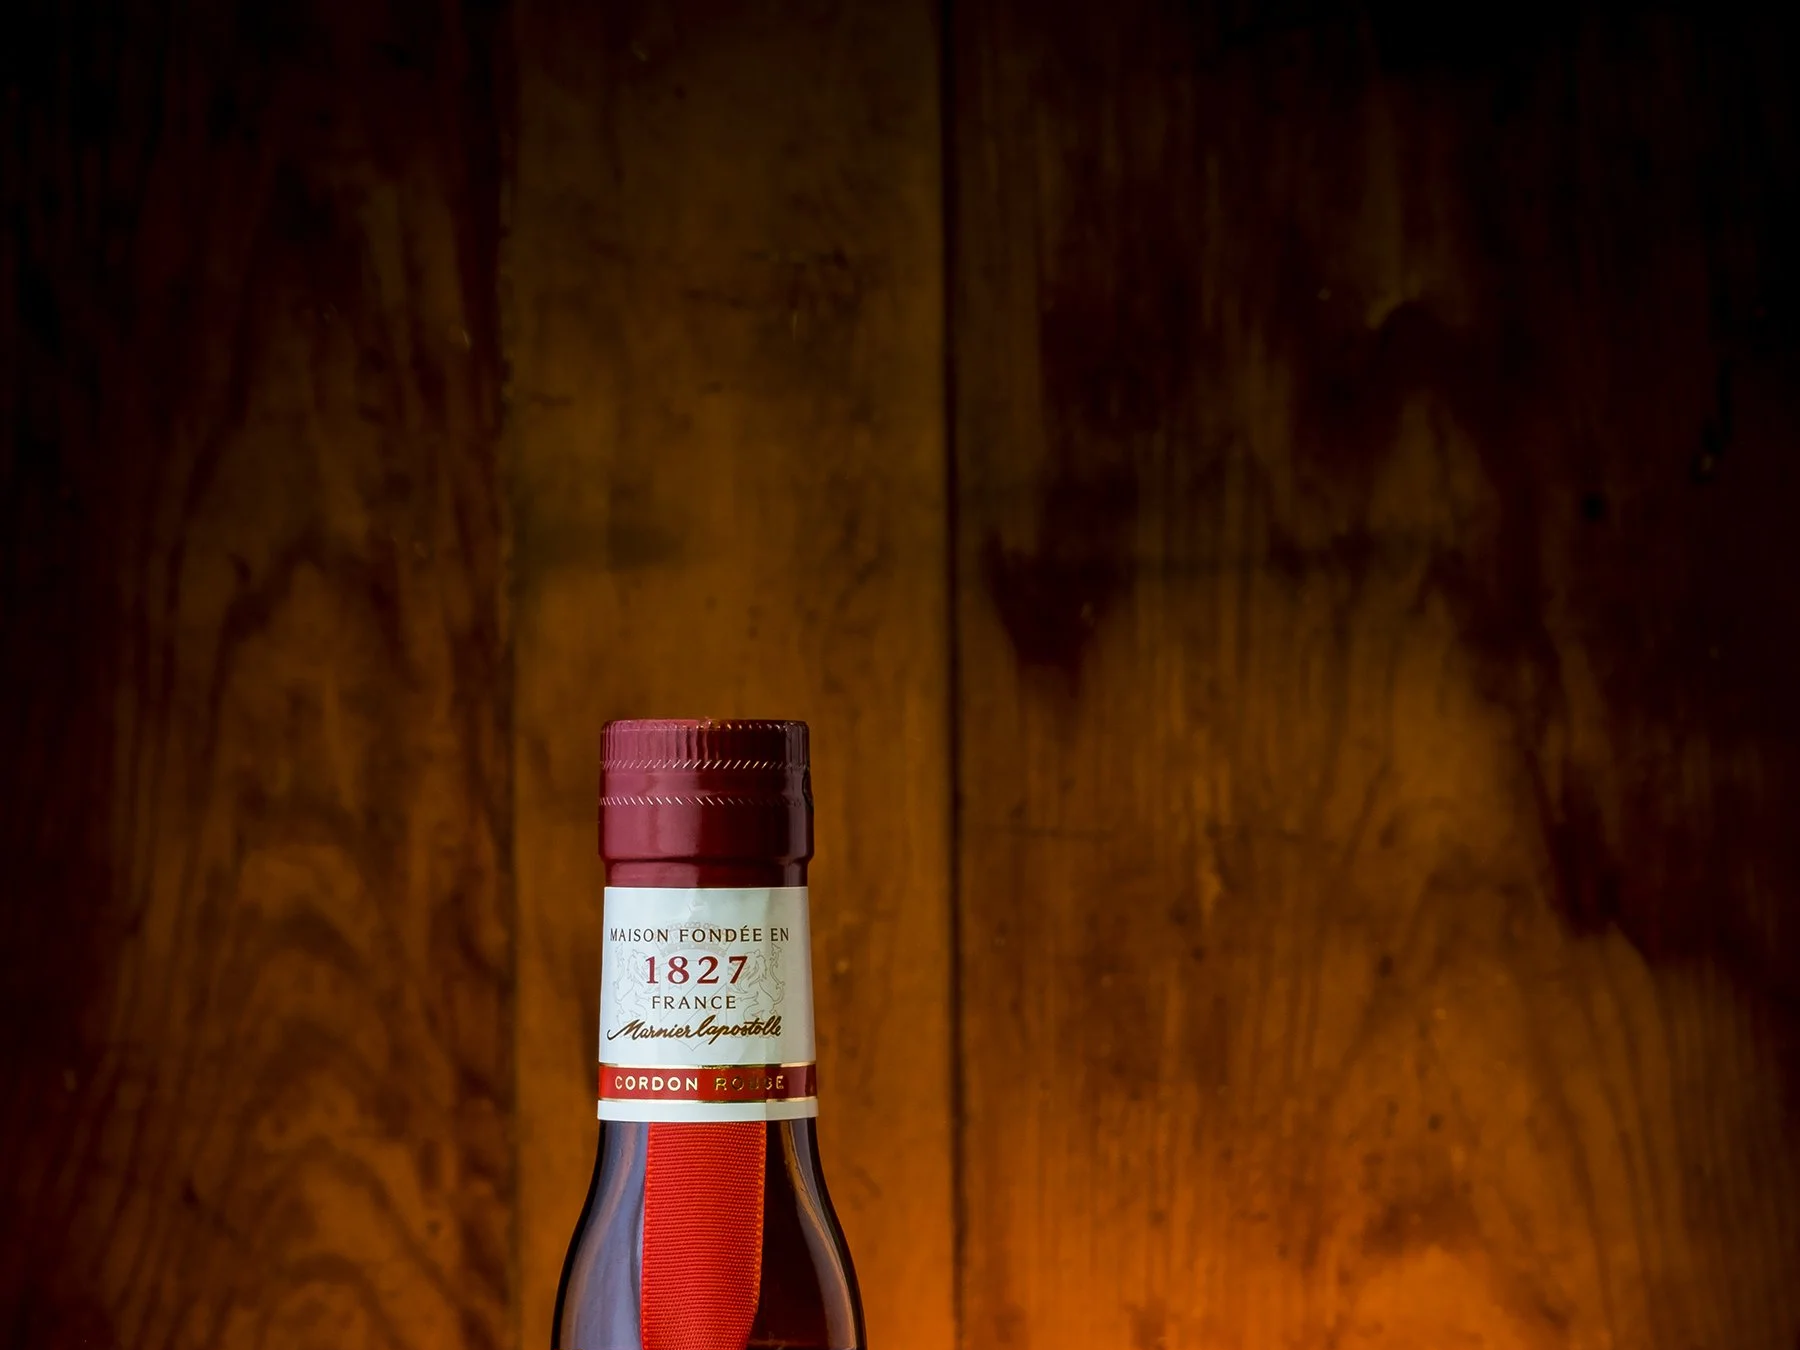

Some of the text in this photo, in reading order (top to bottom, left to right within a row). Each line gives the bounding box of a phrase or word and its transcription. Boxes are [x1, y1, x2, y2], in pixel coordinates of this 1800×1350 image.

[610, 925, 790, 943] MAISON FONDÉE EN
[645, 955, 748, 985] 1827
[651, 995, 737, 1010] FRANCE
[614, 1076, 699, 1092] CORDON
